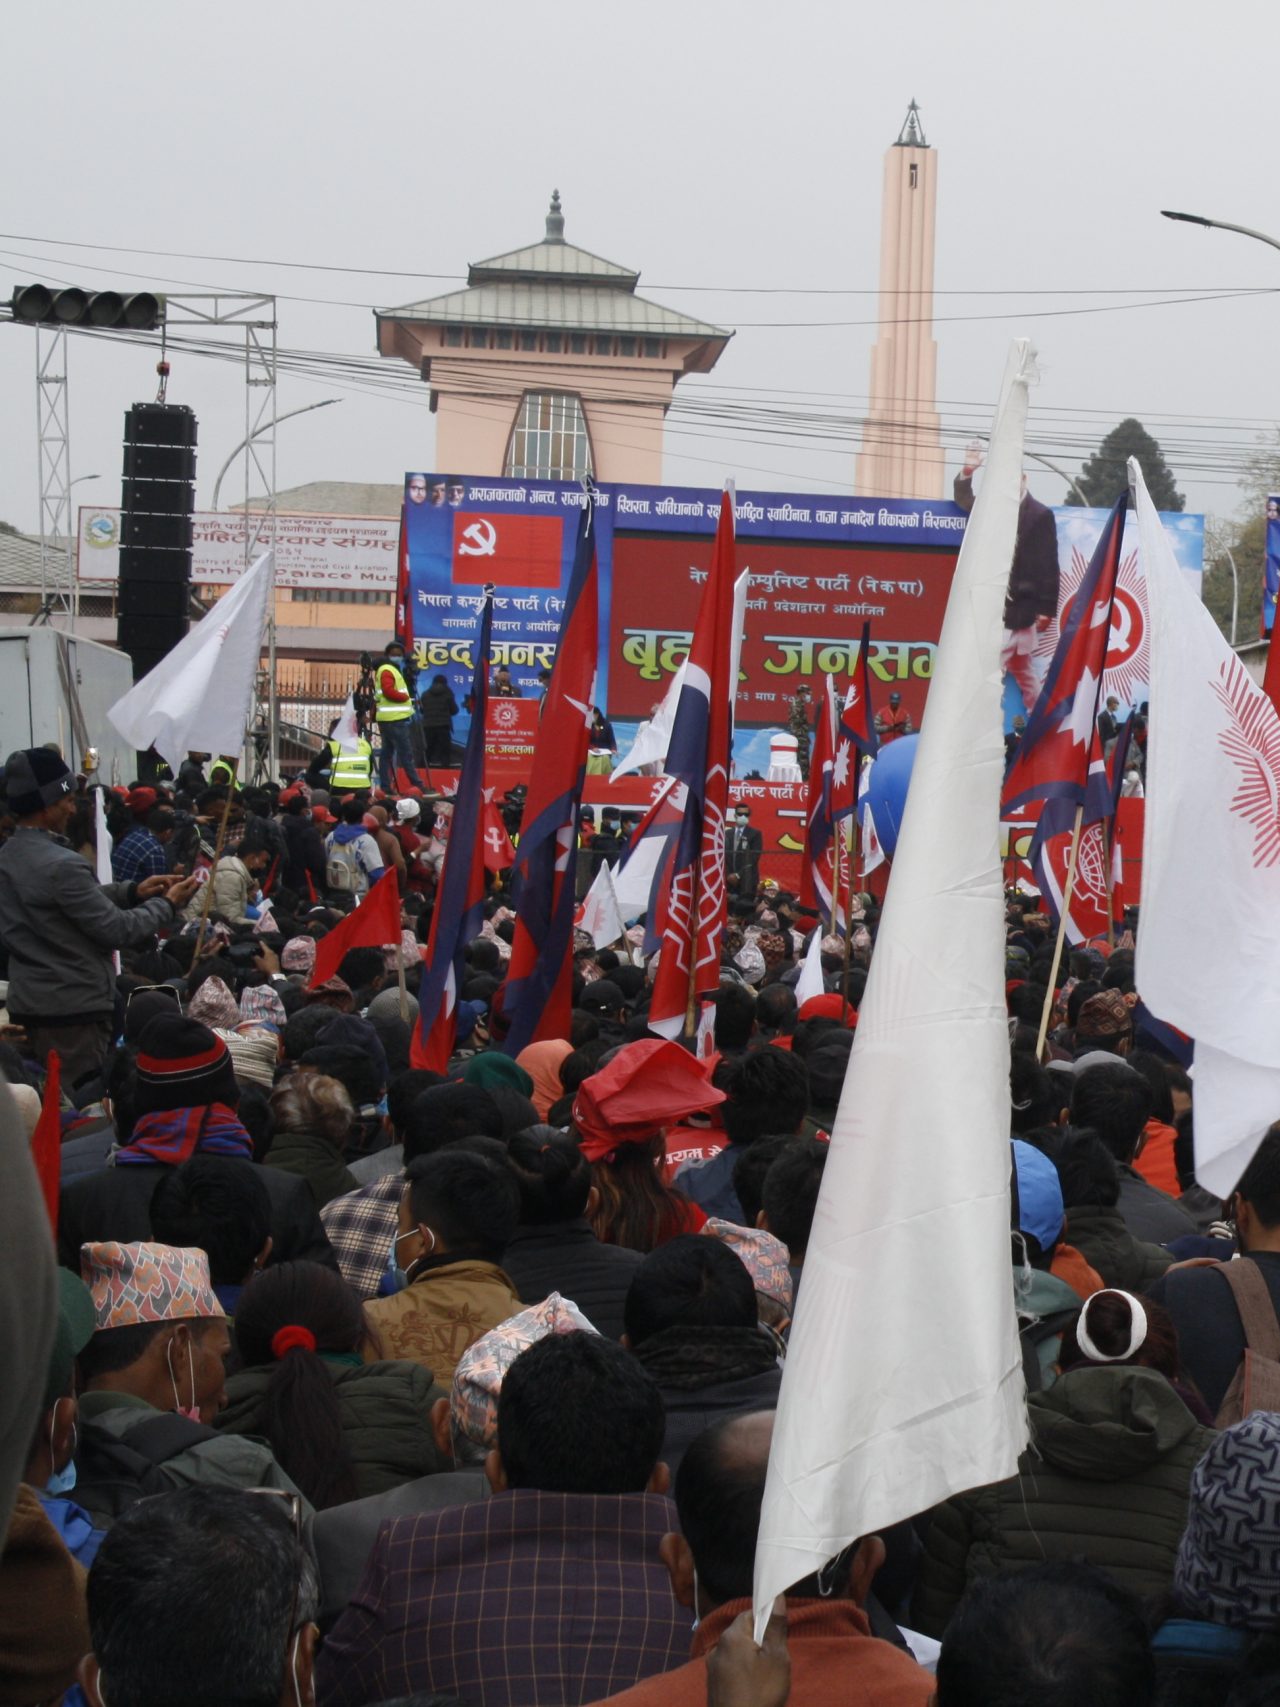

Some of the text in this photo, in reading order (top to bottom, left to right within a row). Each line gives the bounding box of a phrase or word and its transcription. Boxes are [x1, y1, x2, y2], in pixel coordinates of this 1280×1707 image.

[469, 486, 527, 503] अराजकताको
[816, 509, 838, 525] ताजा
[840, 509, 875, 527] जनादेश
[878, 508, 919, 529] विकासको
[815, 573, 851, 592] पार्टी
[857, 575, 925, 598] (नेकपा)
[418, 590, 453, 608] नेपाल
[512, 595, 540, 611] पार्टी
[833, 603, 886, 617] आयोजित
[442, 617, 478, 629] बागमती
[61, 781, 70, 792] K
[769, 783, 794, 800] पार्टी
